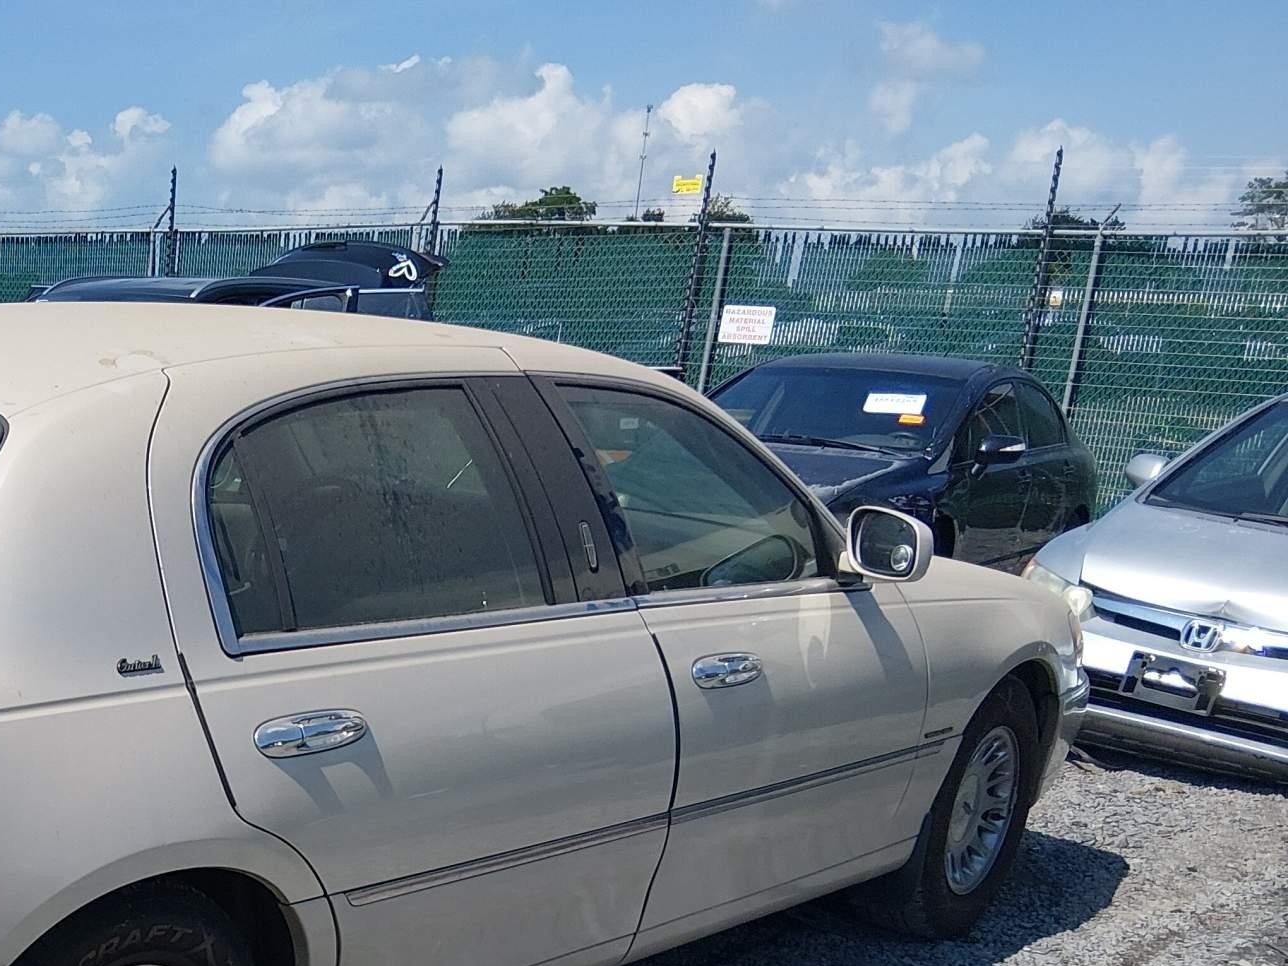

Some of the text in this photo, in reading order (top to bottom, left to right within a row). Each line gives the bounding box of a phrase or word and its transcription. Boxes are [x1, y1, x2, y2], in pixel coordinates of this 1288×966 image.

[725, 308, 773, 317] HAZARDOUS
[728, 317, 766, 325] MATERIAL
[721, 334, 768, 342] ABSORBENT
